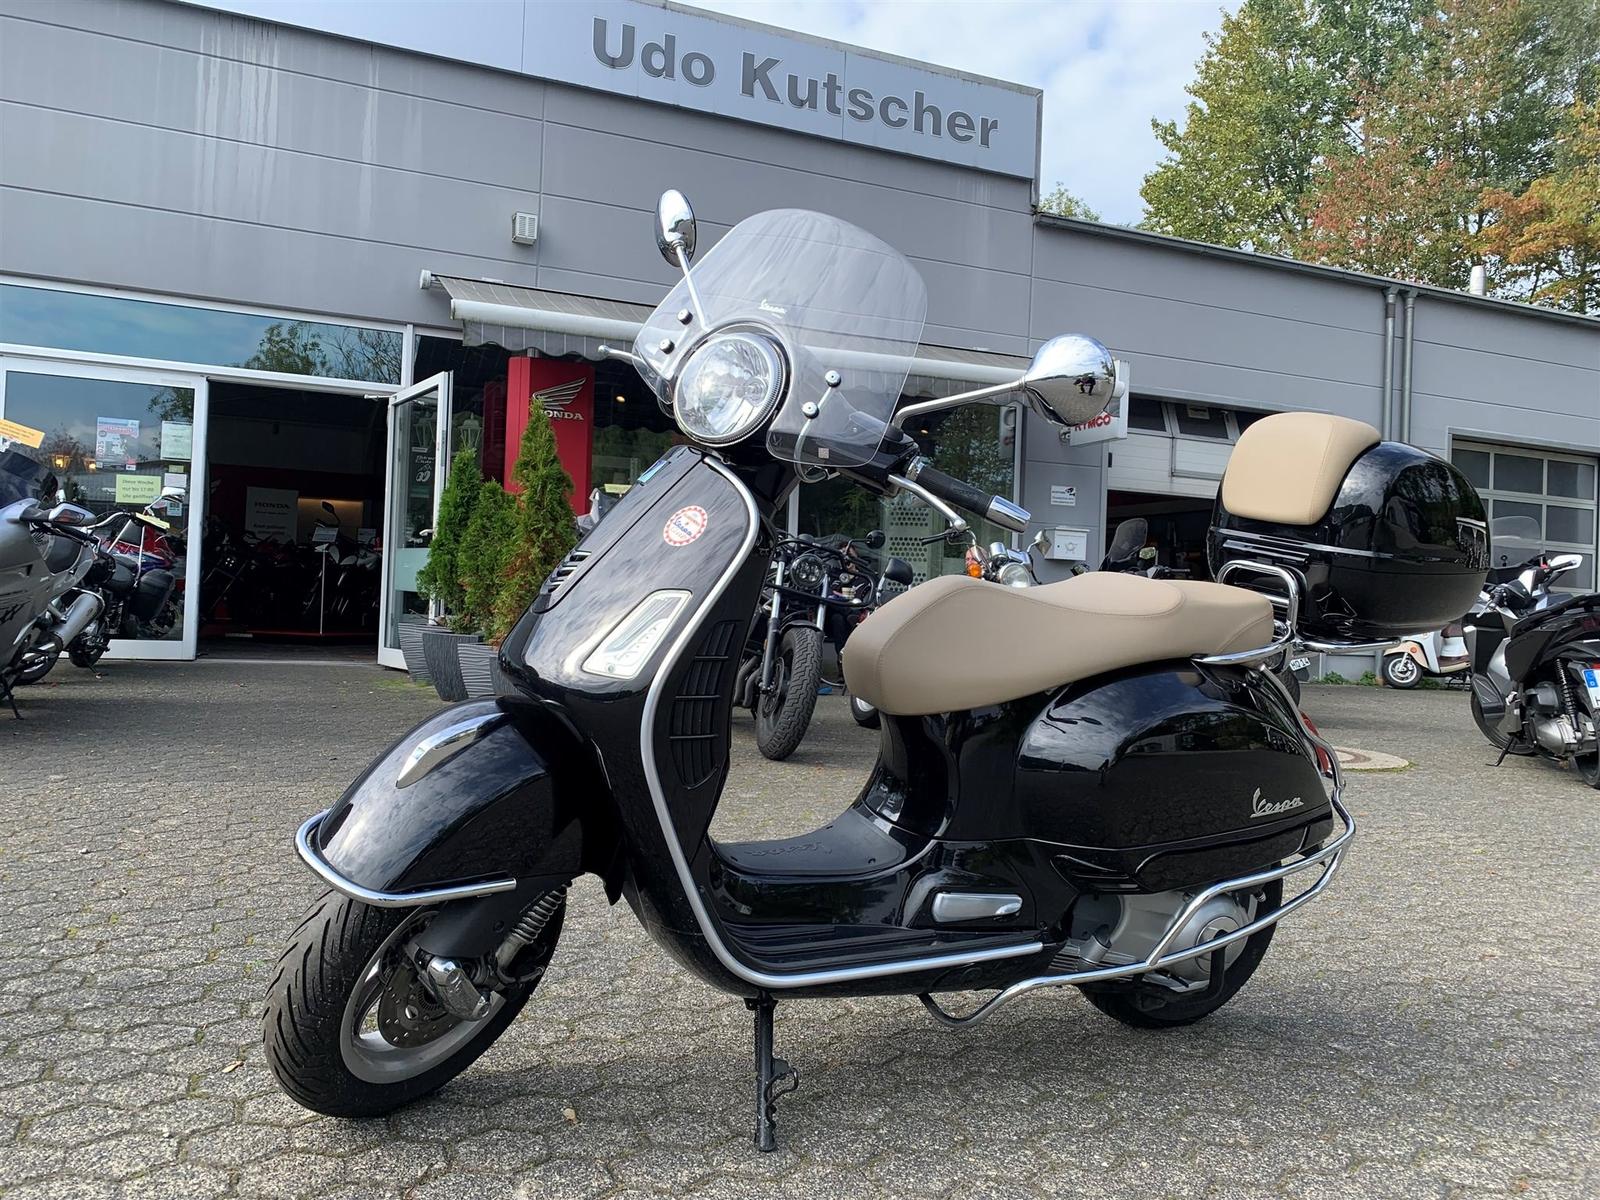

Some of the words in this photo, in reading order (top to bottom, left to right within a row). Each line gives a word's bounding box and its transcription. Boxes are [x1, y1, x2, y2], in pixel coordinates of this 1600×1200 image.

[591, 15, 716, 88] Udo
[739, 49, 1000, 148] Kutscher
[1250, 786, 1305, 818] Vespa
